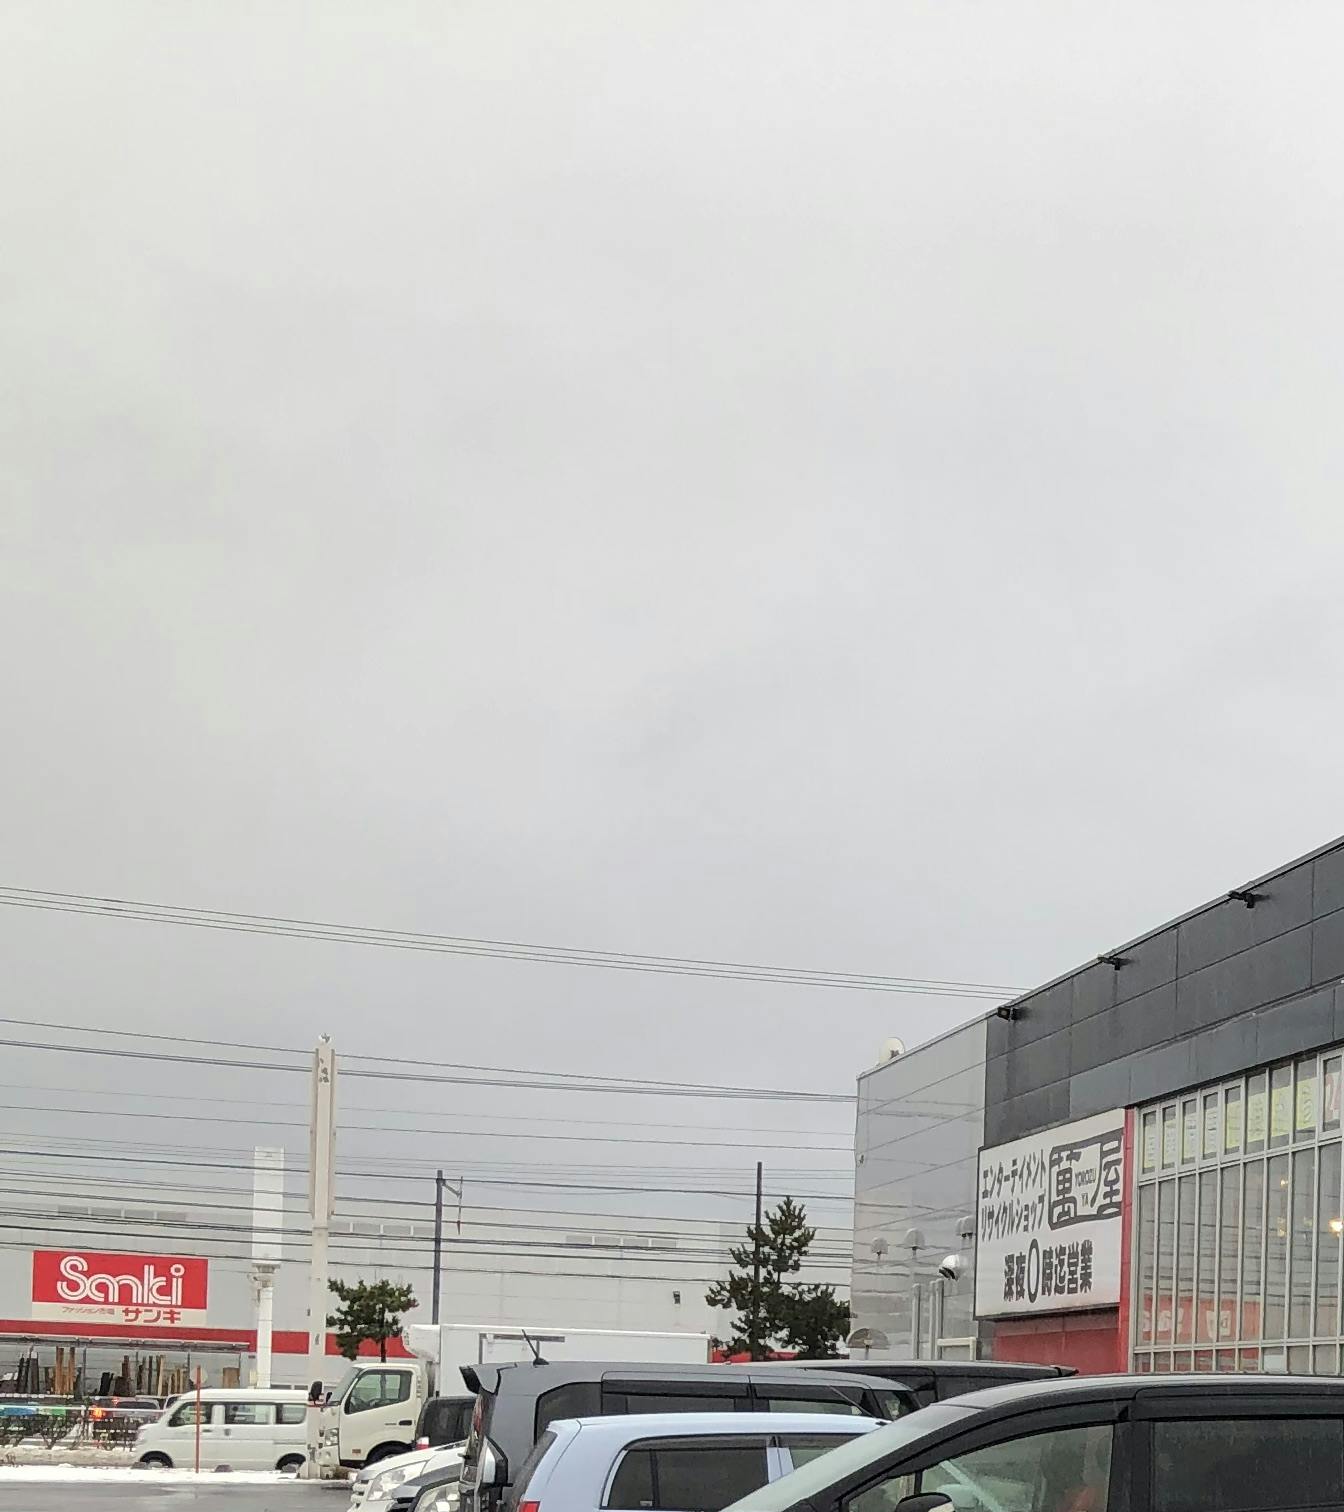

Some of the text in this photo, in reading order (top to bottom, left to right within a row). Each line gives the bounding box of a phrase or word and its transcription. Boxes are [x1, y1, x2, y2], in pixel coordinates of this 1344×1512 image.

[982, 1149, 1047, 1199] エンターテイメント
[981, 1189, 1047, 1242] リサイクルショップ
[57, 1255, 185, 1306] Sanki
[122, 1307, 182, 1324] サンキ
